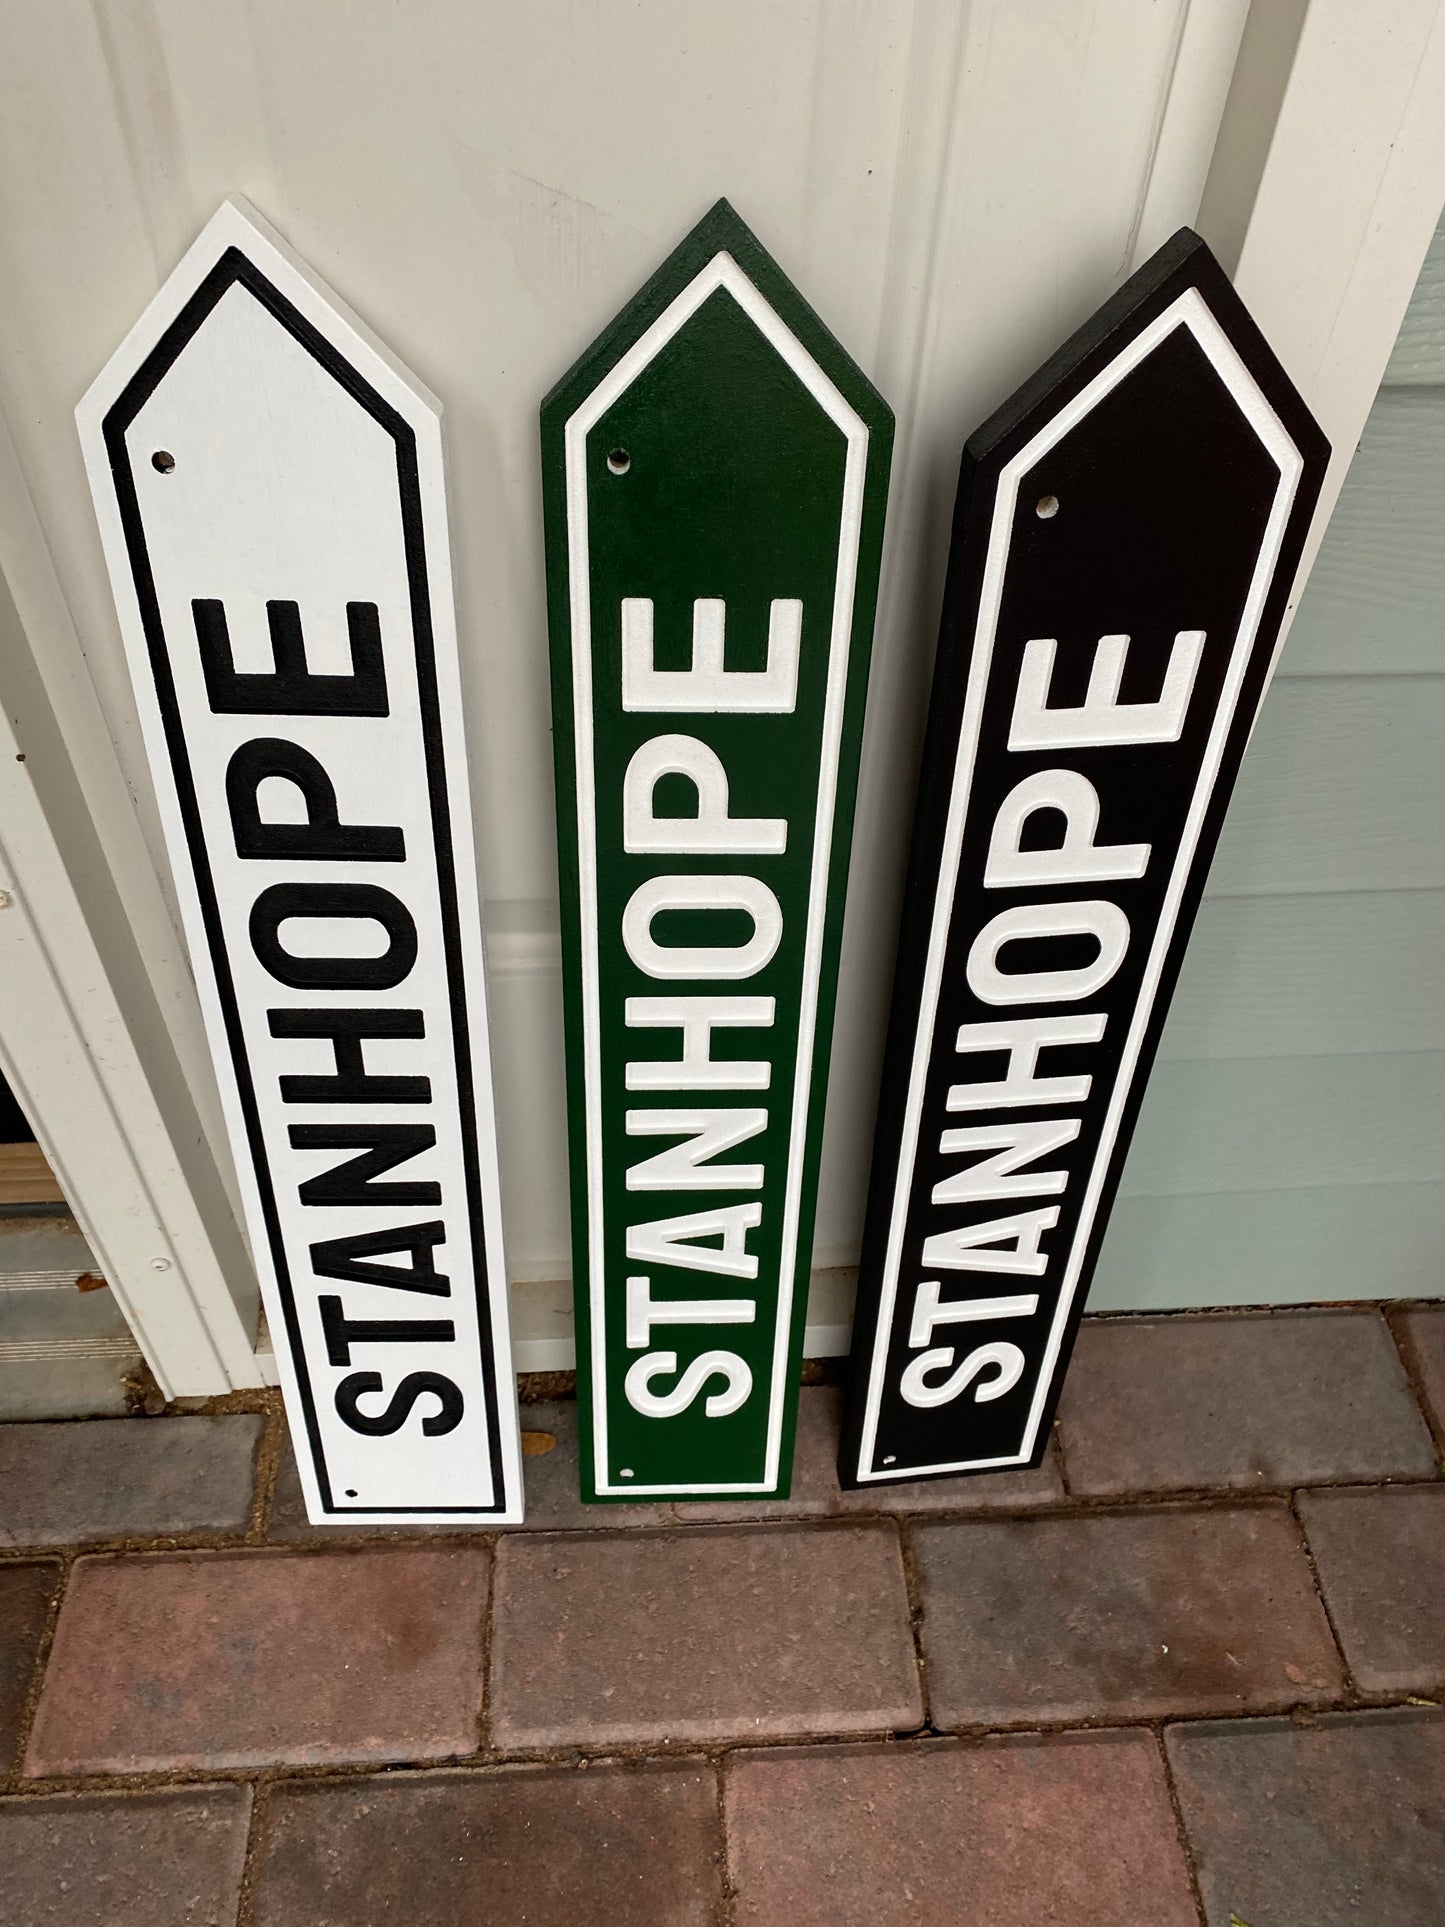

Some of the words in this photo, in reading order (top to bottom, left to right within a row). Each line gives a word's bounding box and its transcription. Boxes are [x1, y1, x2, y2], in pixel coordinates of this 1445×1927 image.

[191, 598, 465, 1437] STANHOPE
[620, 596, 804, 1419] STANHOPE
[899, 629, 1207, 1408] STANHOPE
